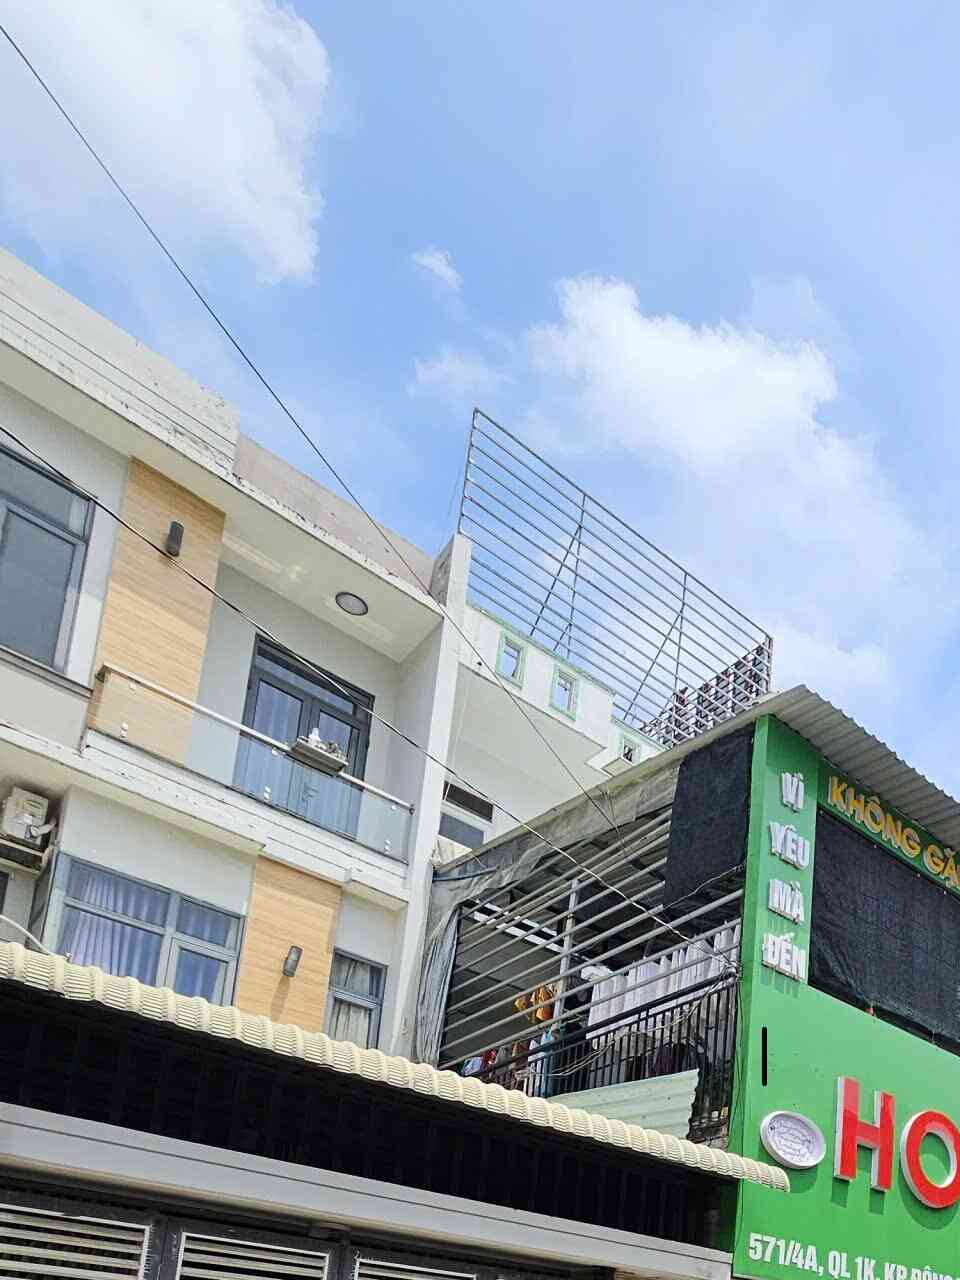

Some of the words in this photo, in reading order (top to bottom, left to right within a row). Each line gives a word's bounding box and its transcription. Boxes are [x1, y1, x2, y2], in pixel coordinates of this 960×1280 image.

[828, 776, 921, 857] KHÔNG
[768, 821, 810, 870] YÊU
[768, 878, 805, 923] MÀ
[762, 931, 808, 981] ĐẾN
[748, 1232, 824, 1277] 571/4A,
[827, 1250, 851, 1280] QL
